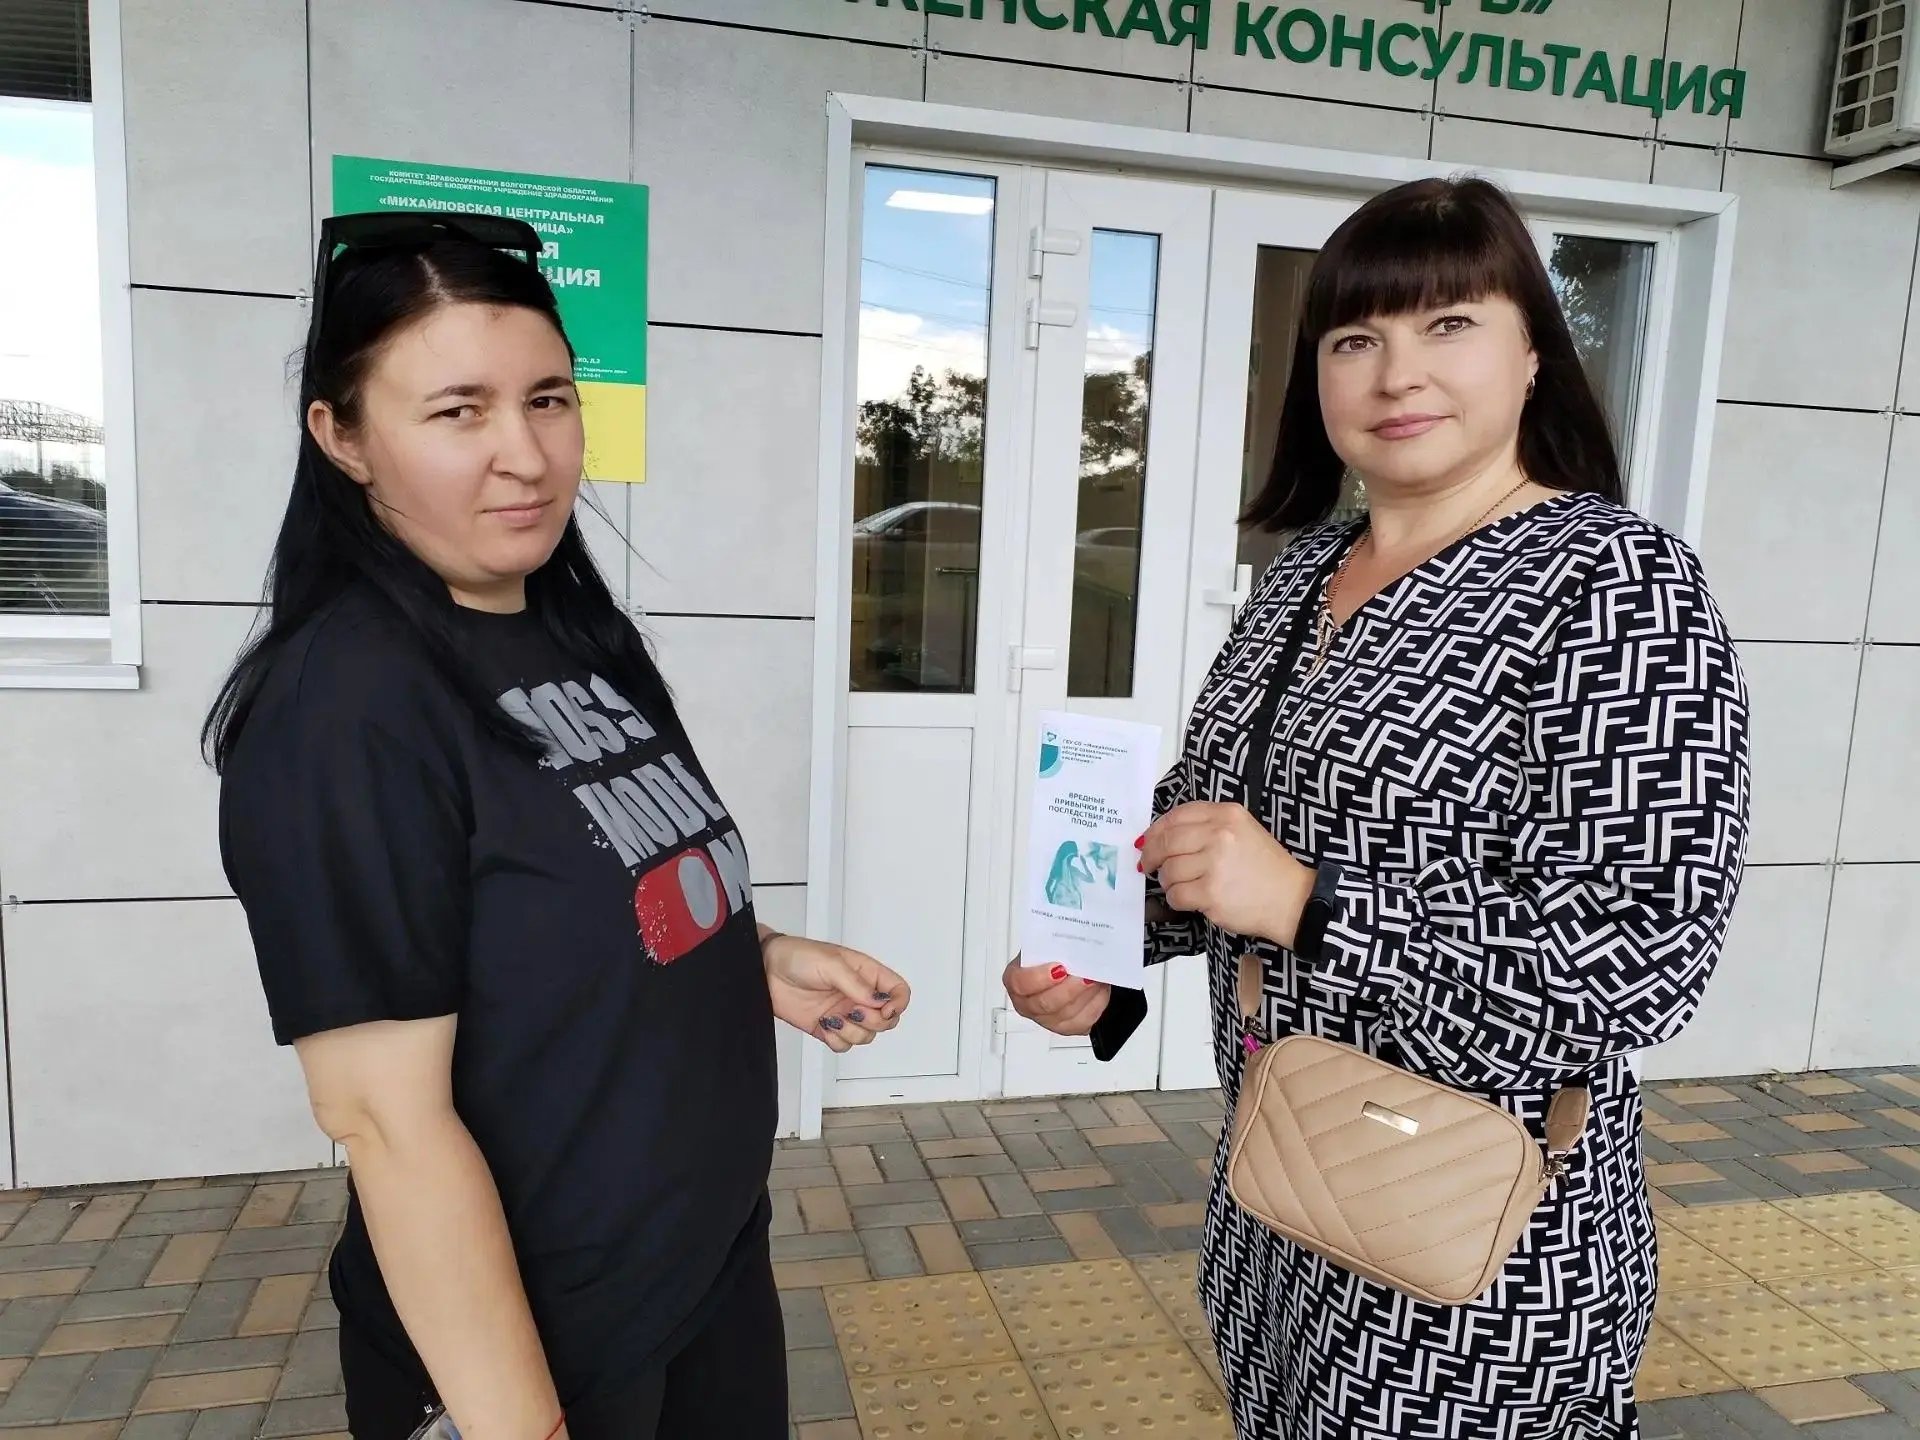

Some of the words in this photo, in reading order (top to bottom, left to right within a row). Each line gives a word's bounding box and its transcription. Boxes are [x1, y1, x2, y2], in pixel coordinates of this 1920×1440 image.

[845, 0, 1209, 50] СКАЯ
[1234, 1, 1747, 119] КОНСУЛЬТАЦИЯ
[370, 175, 443, 188] ГОСУДАРСТВЕННОЕ
[444, 183, 493, 193] БЮДЖЕТНОЕ
[493, 187, 543, 197] УЧРЕЖДЕНИЕ
[543, 192, 614, 203] ЗДРАВООХРАНЕНИЯ
[389, 170, 424, 179] КОМИТЕТ
[425, 174, 499, 187] ЗДРАВООХРАНЕНИЯ
[500, 181, 561, 192] ВОЛГОГРАДСКОЙ
[562, 187, 597, 196] ОБЛАСТИ
[379, 195, 501, 216] «МИХАЙЛОВСКАЯ
[506, 206, 604, 224] ЦЕНТРАЛЬНАЯ
[528, 221, 574, 235] НИЦА»
[1054, 797, 1098, 812] ПРИВЫЧКИ
[1107, 808, 1119, 816] ИХ
[1068, 792, 1106, 805] ВРЕДНЫЕ
[1048, 805, 1104, 821] ПОСЛЕДСТВИЯ
[1105, 816, 1123, 825] ДЛЯ
[1071, 817, 1098, 828] ПЛОДА
